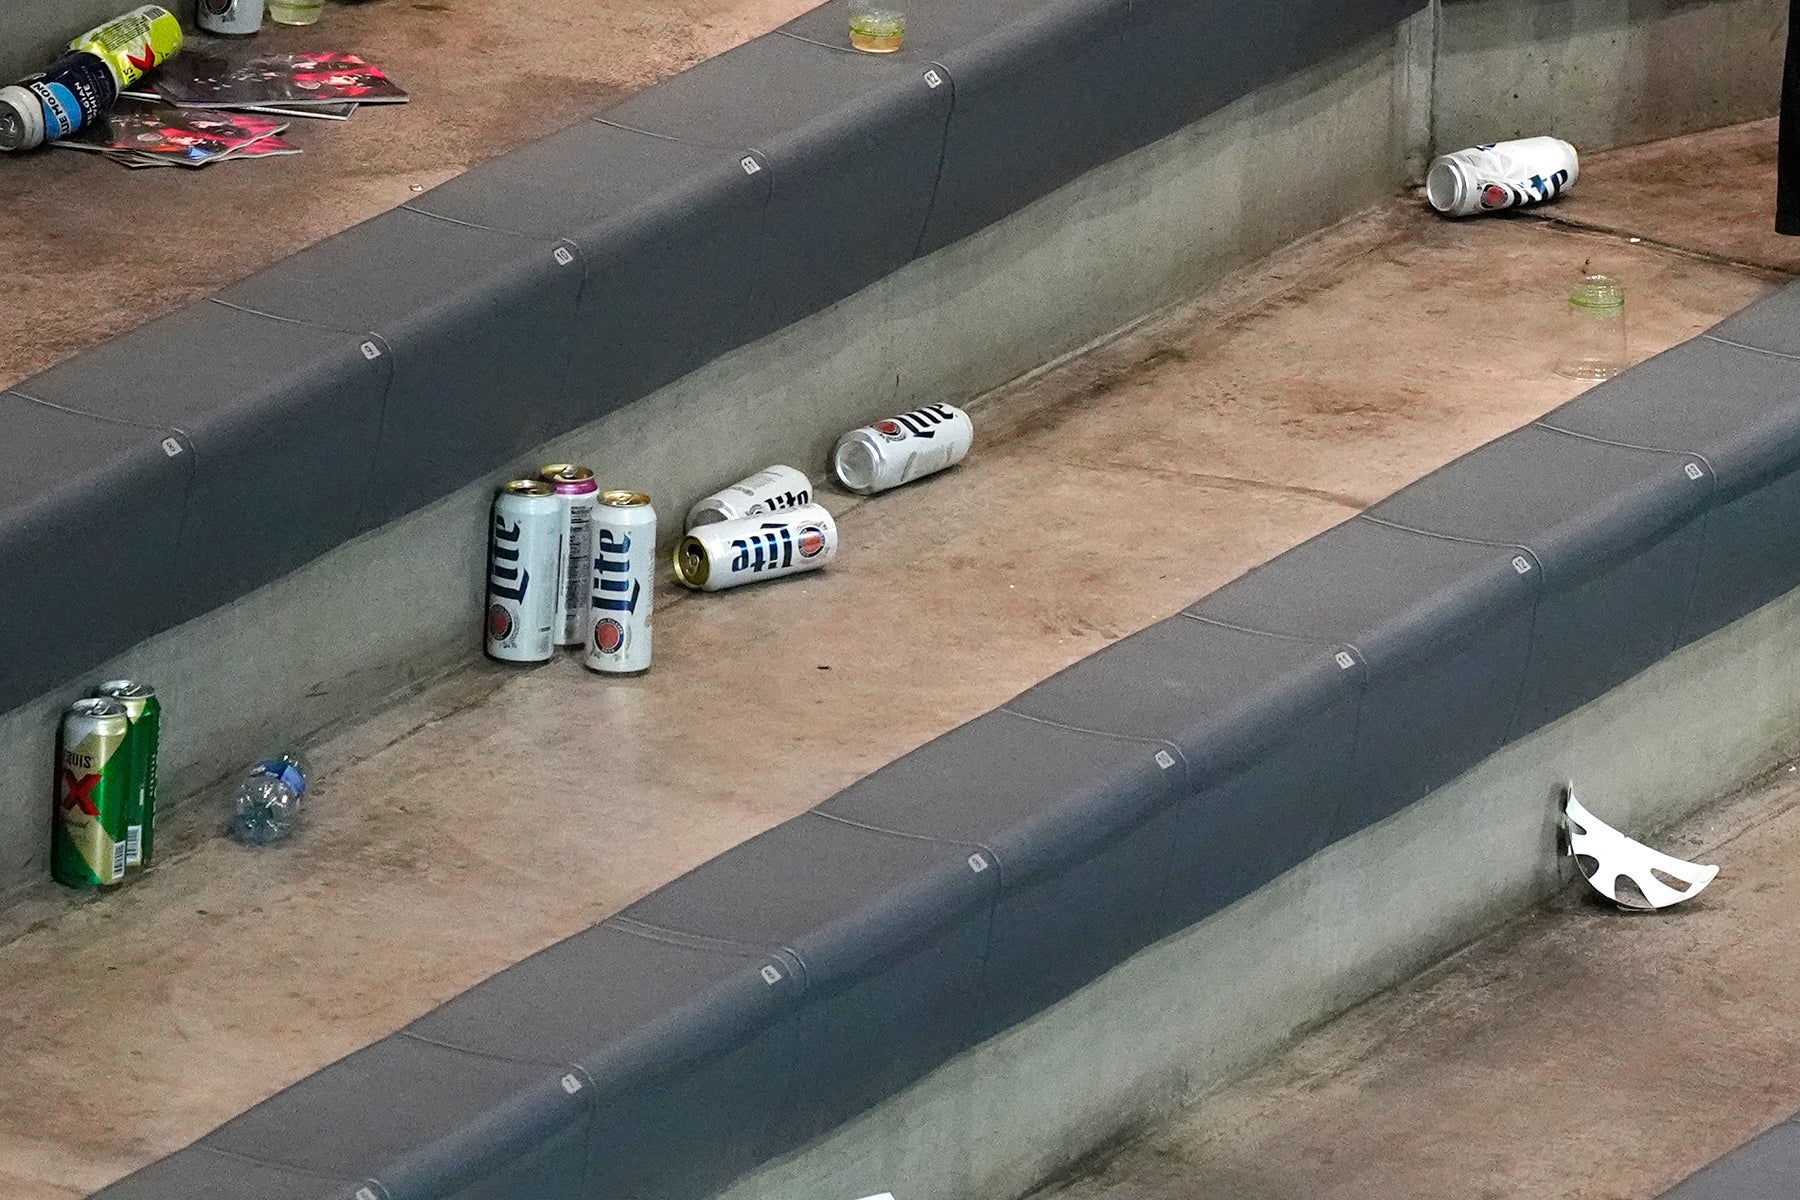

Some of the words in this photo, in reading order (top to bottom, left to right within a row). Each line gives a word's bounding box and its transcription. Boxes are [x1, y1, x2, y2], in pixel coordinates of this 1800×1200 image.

[32, 82, 63, 116] MOON
[73, 81, 94, 125] ELGIAN
[591, 529, 640, 615] Lite
[731, 522, 793, 574] Lite
